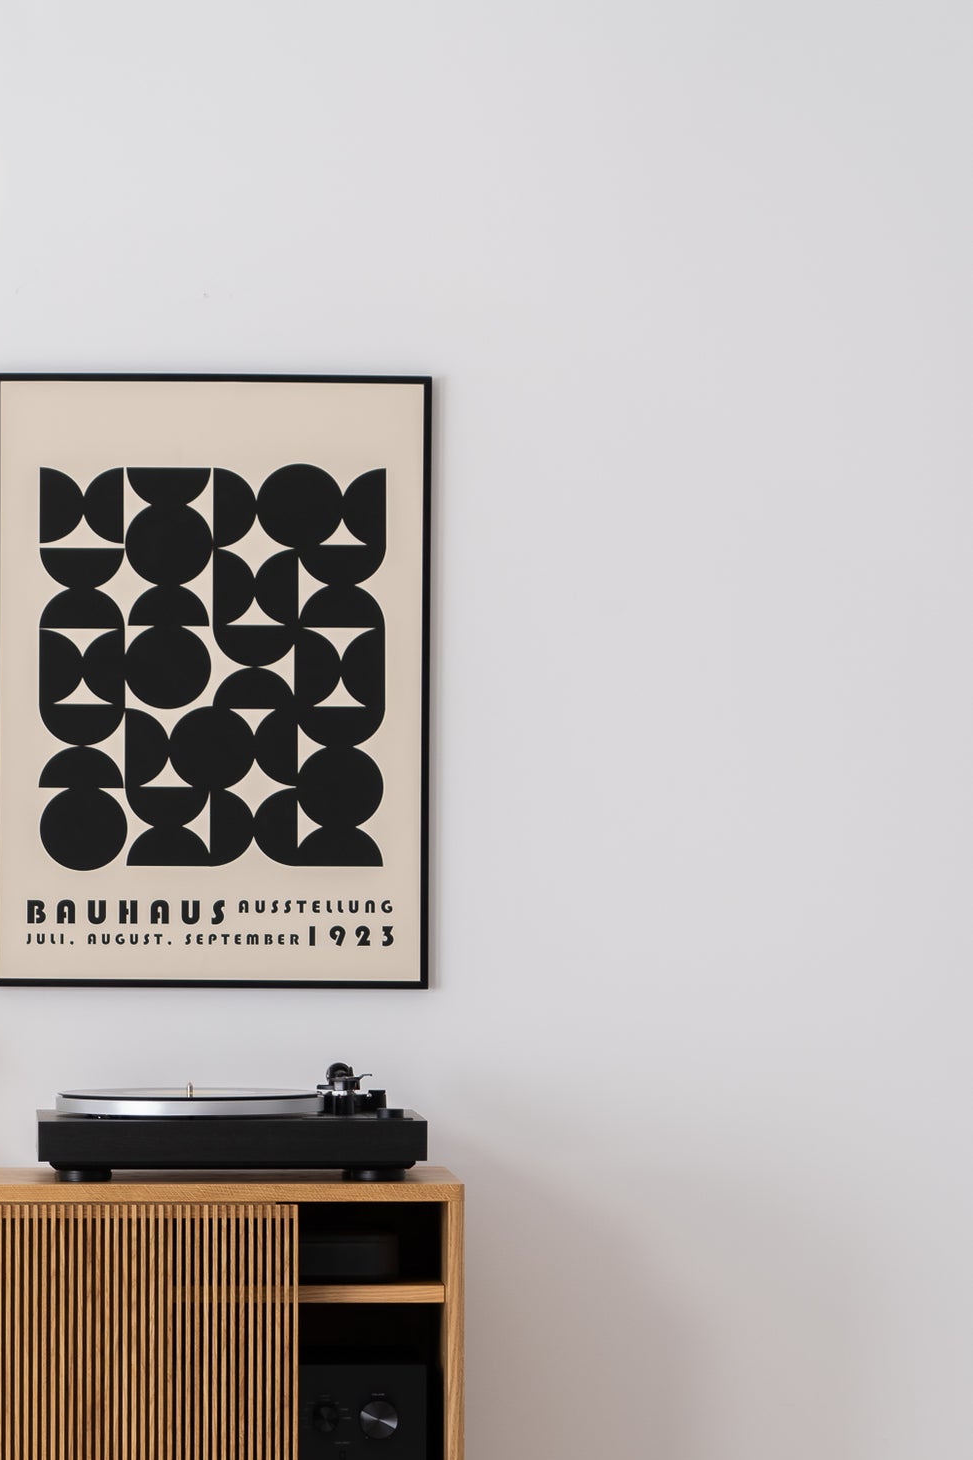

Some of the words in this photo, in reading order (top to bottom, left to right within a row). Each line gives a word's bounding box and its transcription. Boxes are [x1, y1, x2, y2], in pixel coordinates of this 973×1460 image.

[26, 899, 226, 925] BAUHAUS
[238, 899, 393, 914] AUSSTELLUNG
[184, 933, 300, 946] SEPTEMBER
[308, 925, 396, 947] 1923
